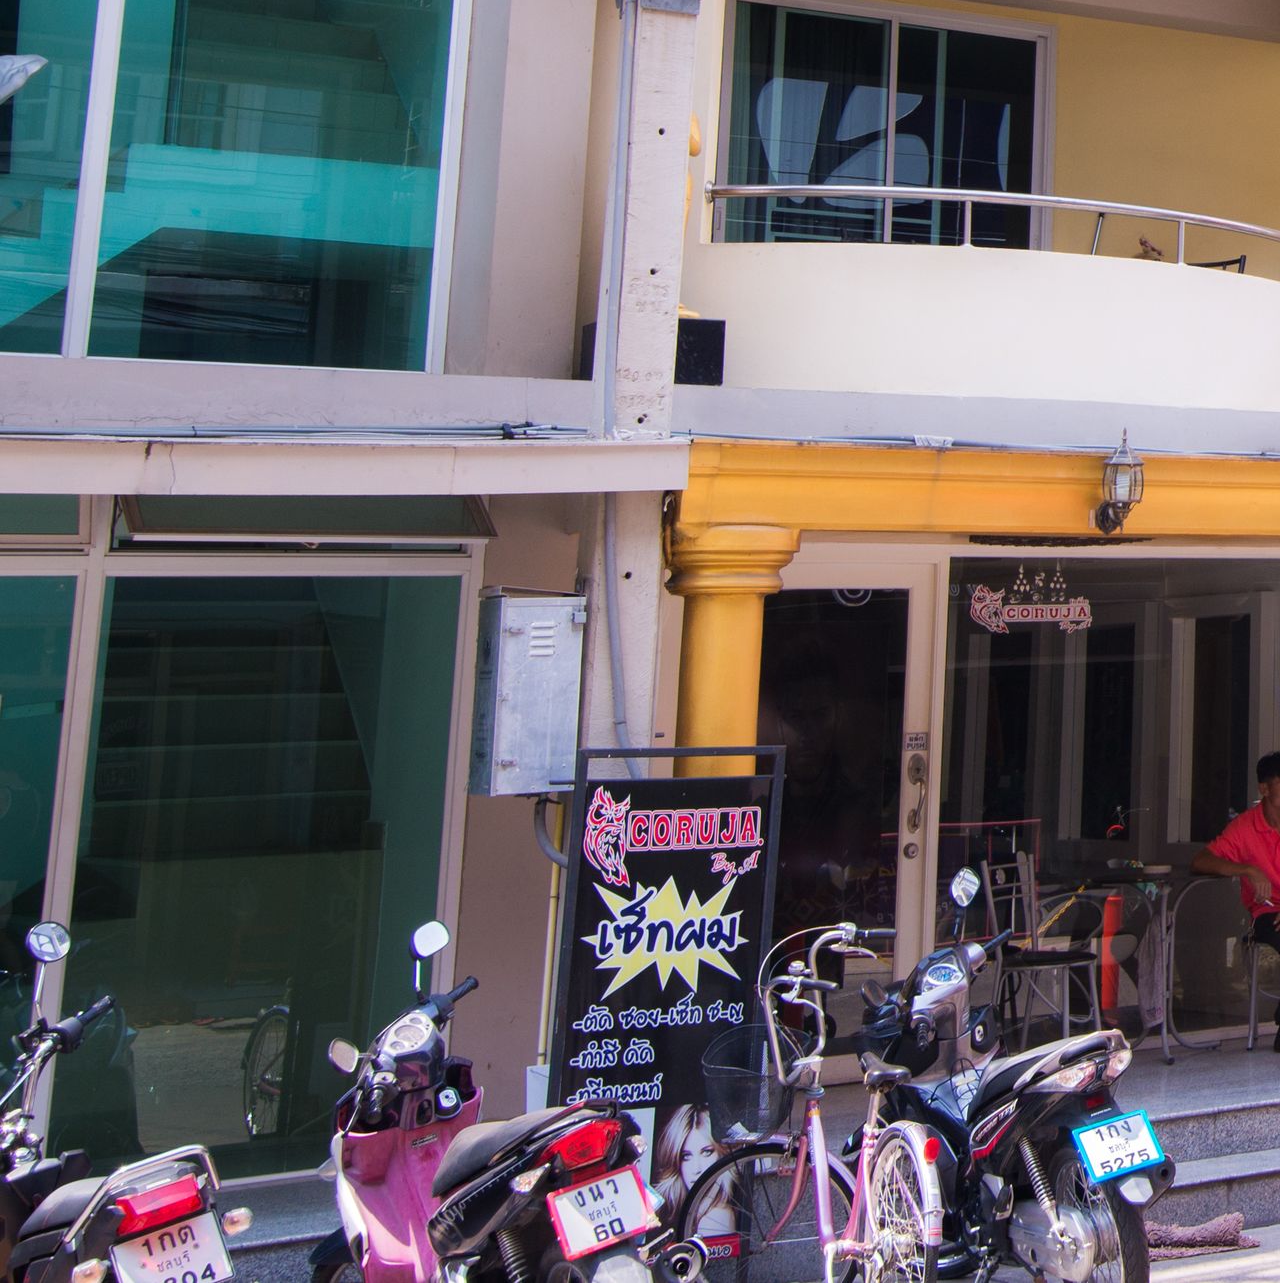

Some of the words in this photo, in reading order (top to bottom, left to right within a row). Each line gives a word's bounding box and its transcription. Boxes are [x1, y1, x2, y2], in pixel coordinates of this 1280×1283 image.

[1006, 608, 1088, 619] CORUJA
[1099, 1148, 1151, 1175] 5275
[593, 1217, 626, 1243] 60
[156, 1250, 191, 1273] ชลบุรี
